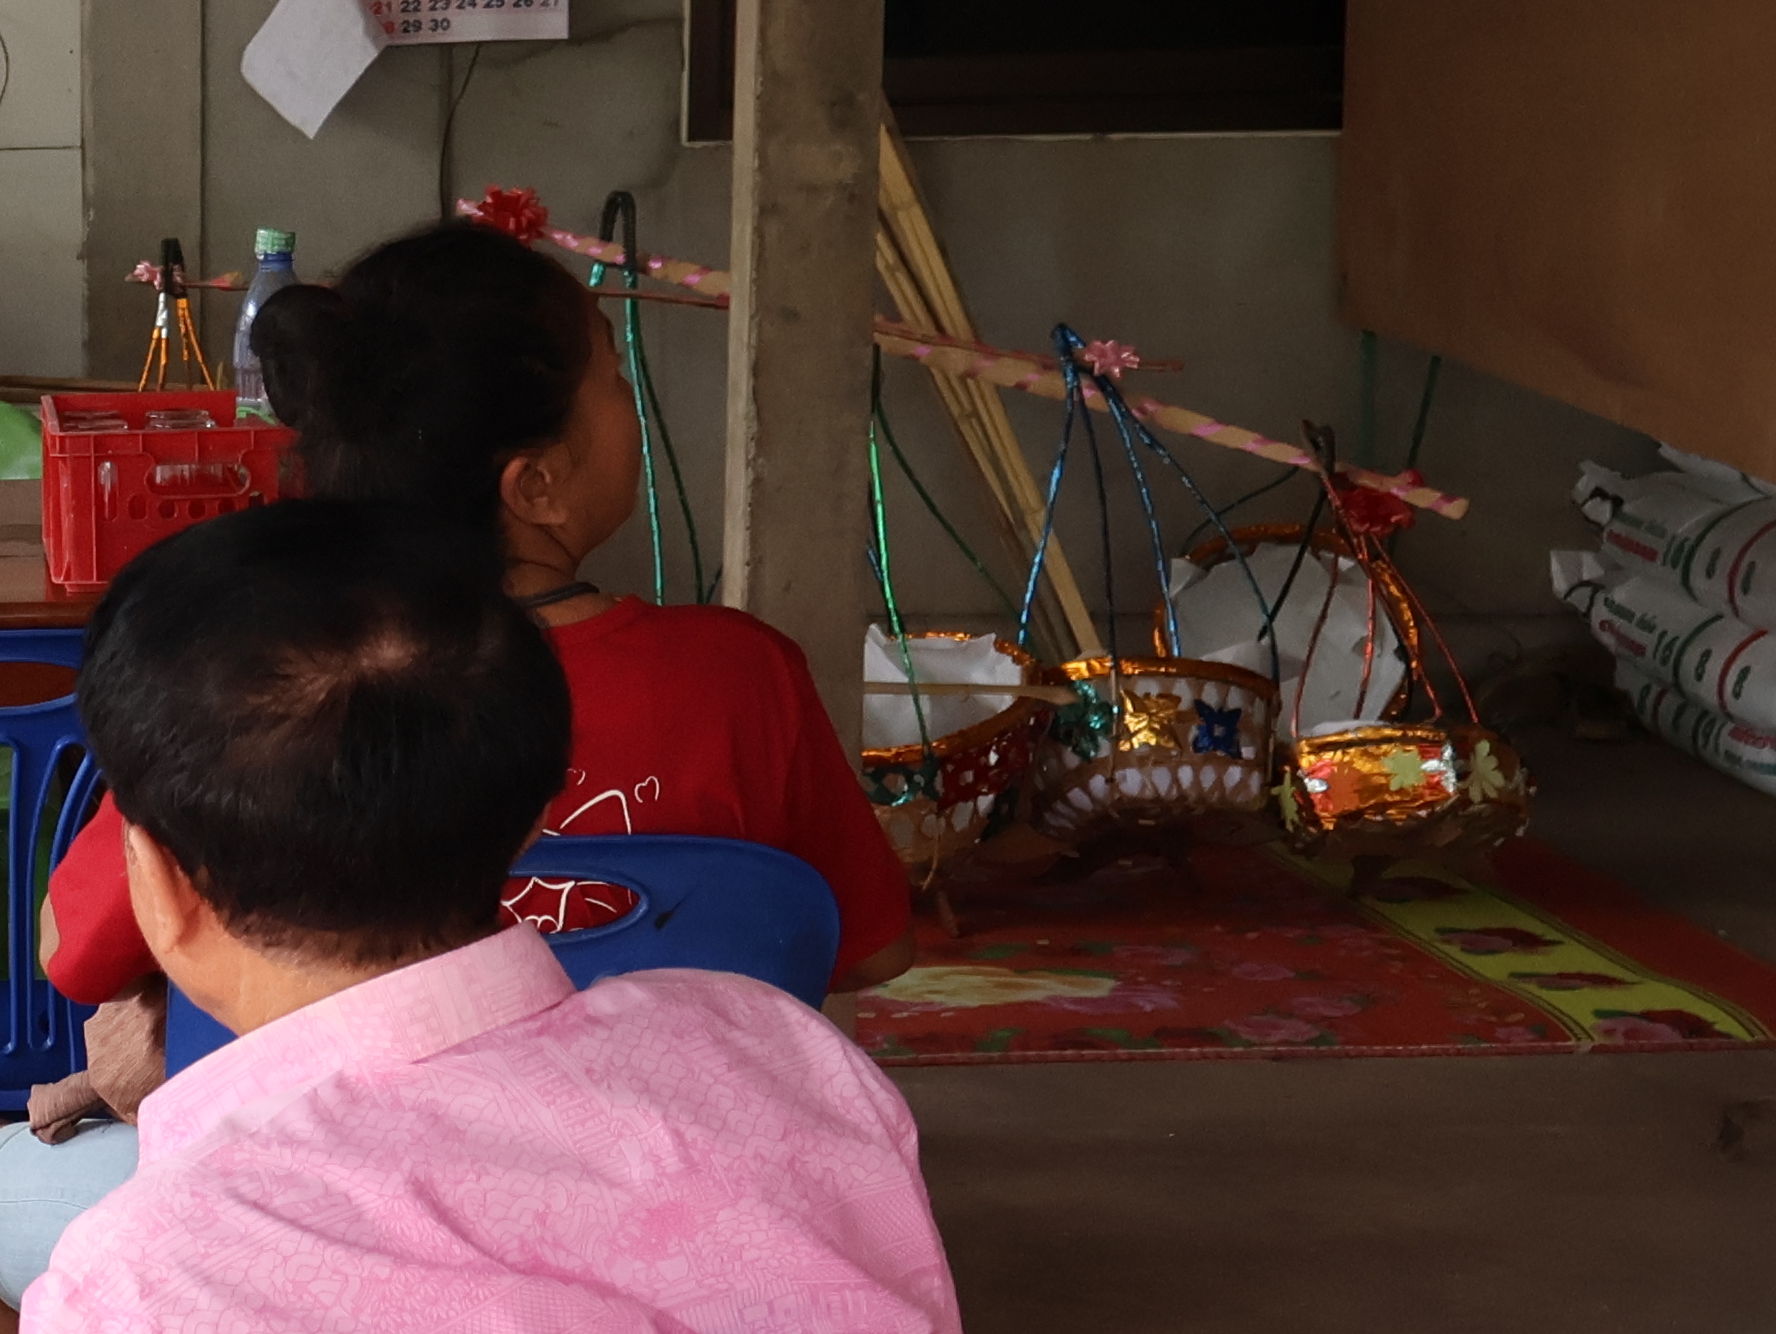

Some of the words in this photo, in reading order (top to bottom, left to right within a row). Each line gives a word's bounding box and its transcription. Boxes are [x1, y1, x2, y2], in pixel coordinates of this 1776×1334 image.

[372, 2, 393, 17] 21
[400, 0, 422, 14] 22
[401, 18, 423, 34] 29
[428, 17, 451, 32] 30
